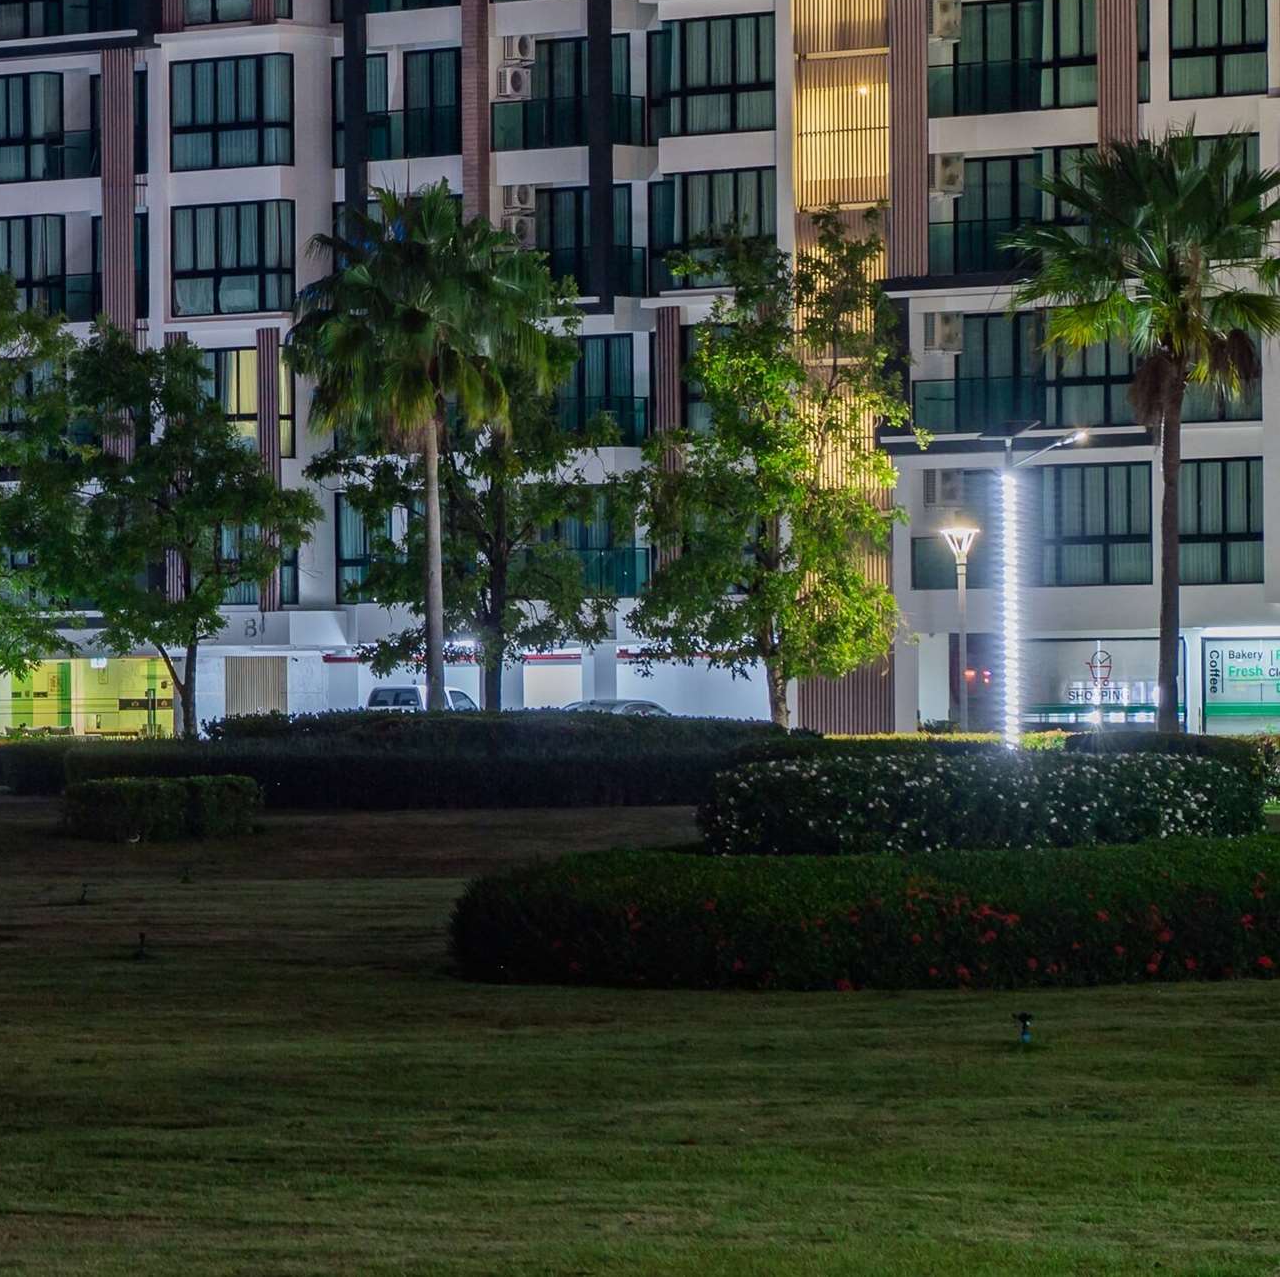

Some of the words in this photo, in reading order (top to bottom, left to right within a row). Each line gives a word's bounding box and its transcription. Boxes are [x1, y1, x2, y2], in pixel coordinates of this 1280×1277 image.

[1228, 650, 1263, 662] Bakery
[1209, 650, 1220, 694] Coffee
[1228, 665, 1263, 676] Fresh
[1068, 690, 1130, 701] SHOPIN
